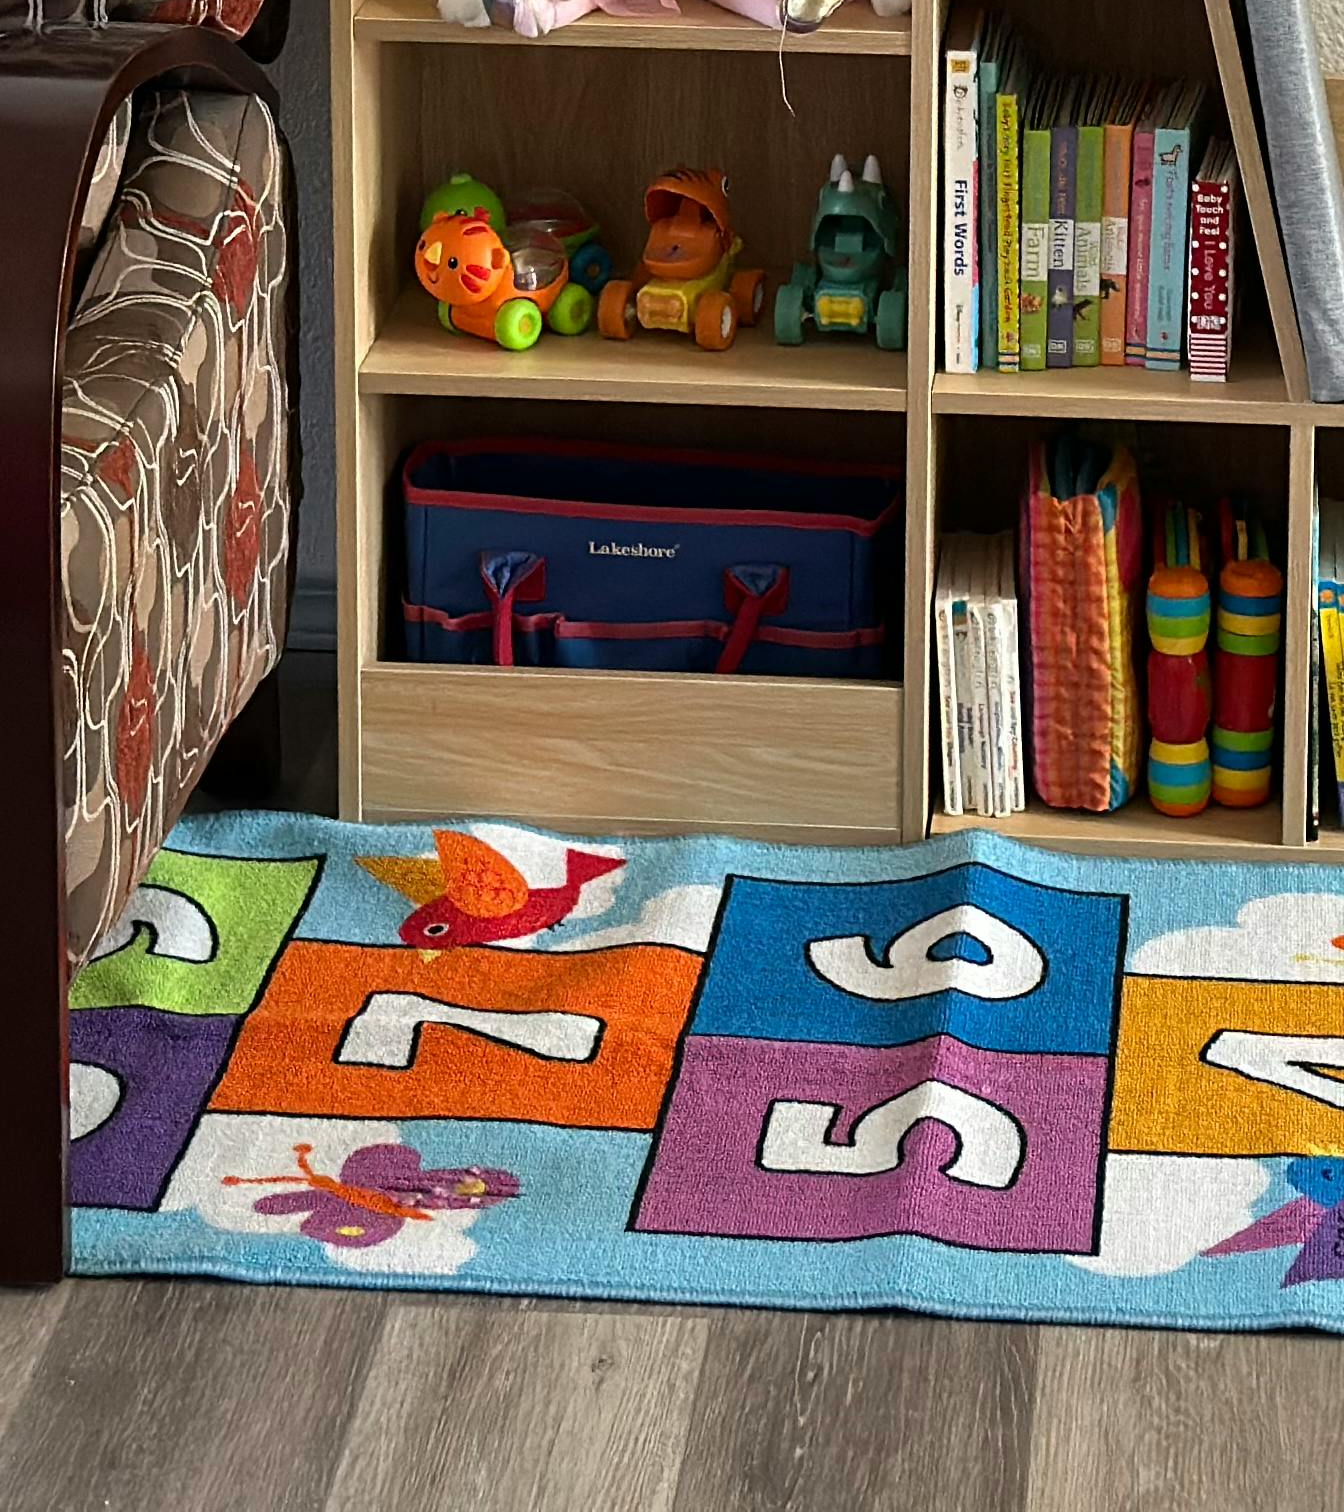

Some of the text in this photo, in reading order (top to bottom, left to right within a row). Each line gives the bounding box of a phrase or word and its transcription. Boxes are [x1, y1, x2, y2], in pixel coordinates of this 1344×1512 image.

[1196, 205, 1224, 214] Touch
[1197, 195, 1222, 204] Baby
[954, 179, 967, 276] First Words
[1199, 227, 1220, 235] Feel
[1200, 217, 1219, 225] and
[1027, 227, 1044, 278] Farm
[1054, 220, 1069, 268] Kitten
[1076, 226, 1089, 291] Animals
[1204, 249, 1216, 281] Love
[1204, 286, 1216, 310] You
[589, 541, 676, 559] Lakeshore
[333, 990, 605, 1069] 7
[761, 1077, 1027, 1191] 5
